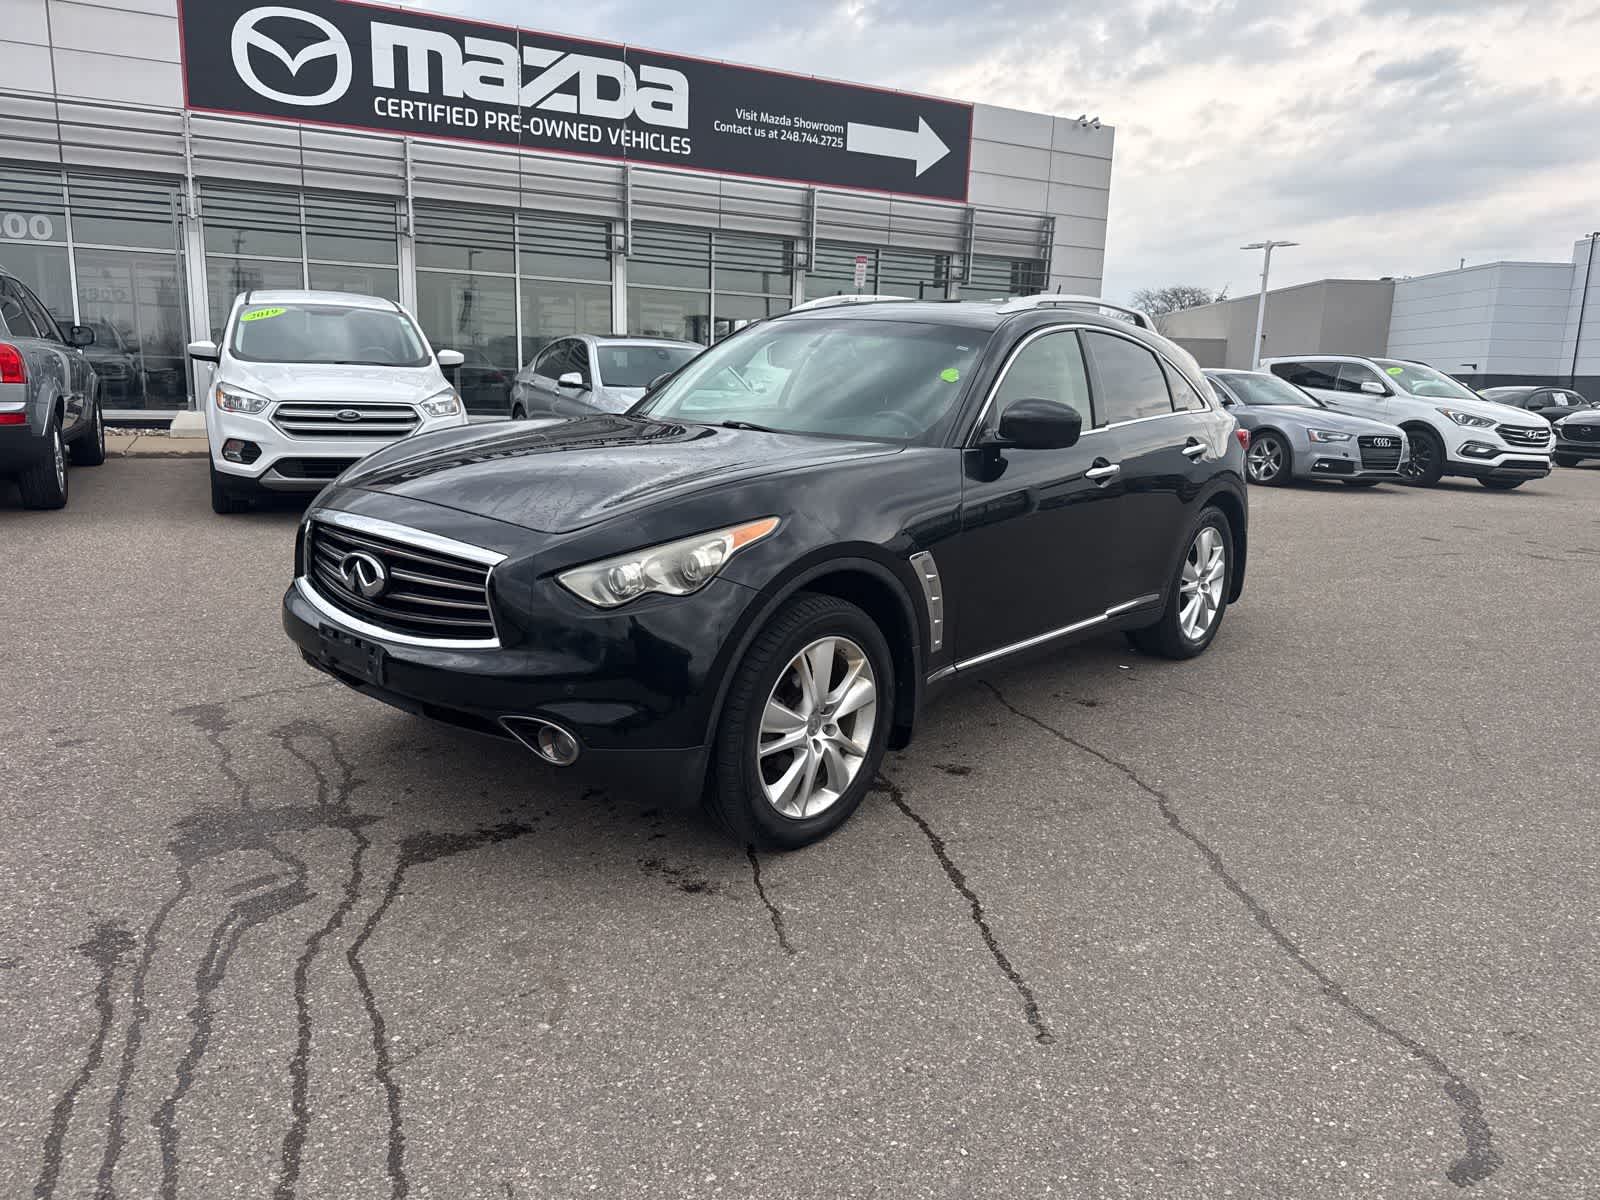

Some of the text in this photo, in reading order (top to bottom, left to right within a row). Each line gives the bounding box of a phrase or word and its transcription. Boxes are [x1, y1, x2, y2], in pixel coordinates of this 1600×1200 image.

[370, 21, 689, 129] mazda
[373, 96, 692, 155] CERTIFIED PRE-OWNED VEHICLES
[713, 120, 844, 148] Contact us at 248.744.2725
[735, 107, 844, 133] Visit Mazda Showroom
[0, 213, 53, 240] 00
